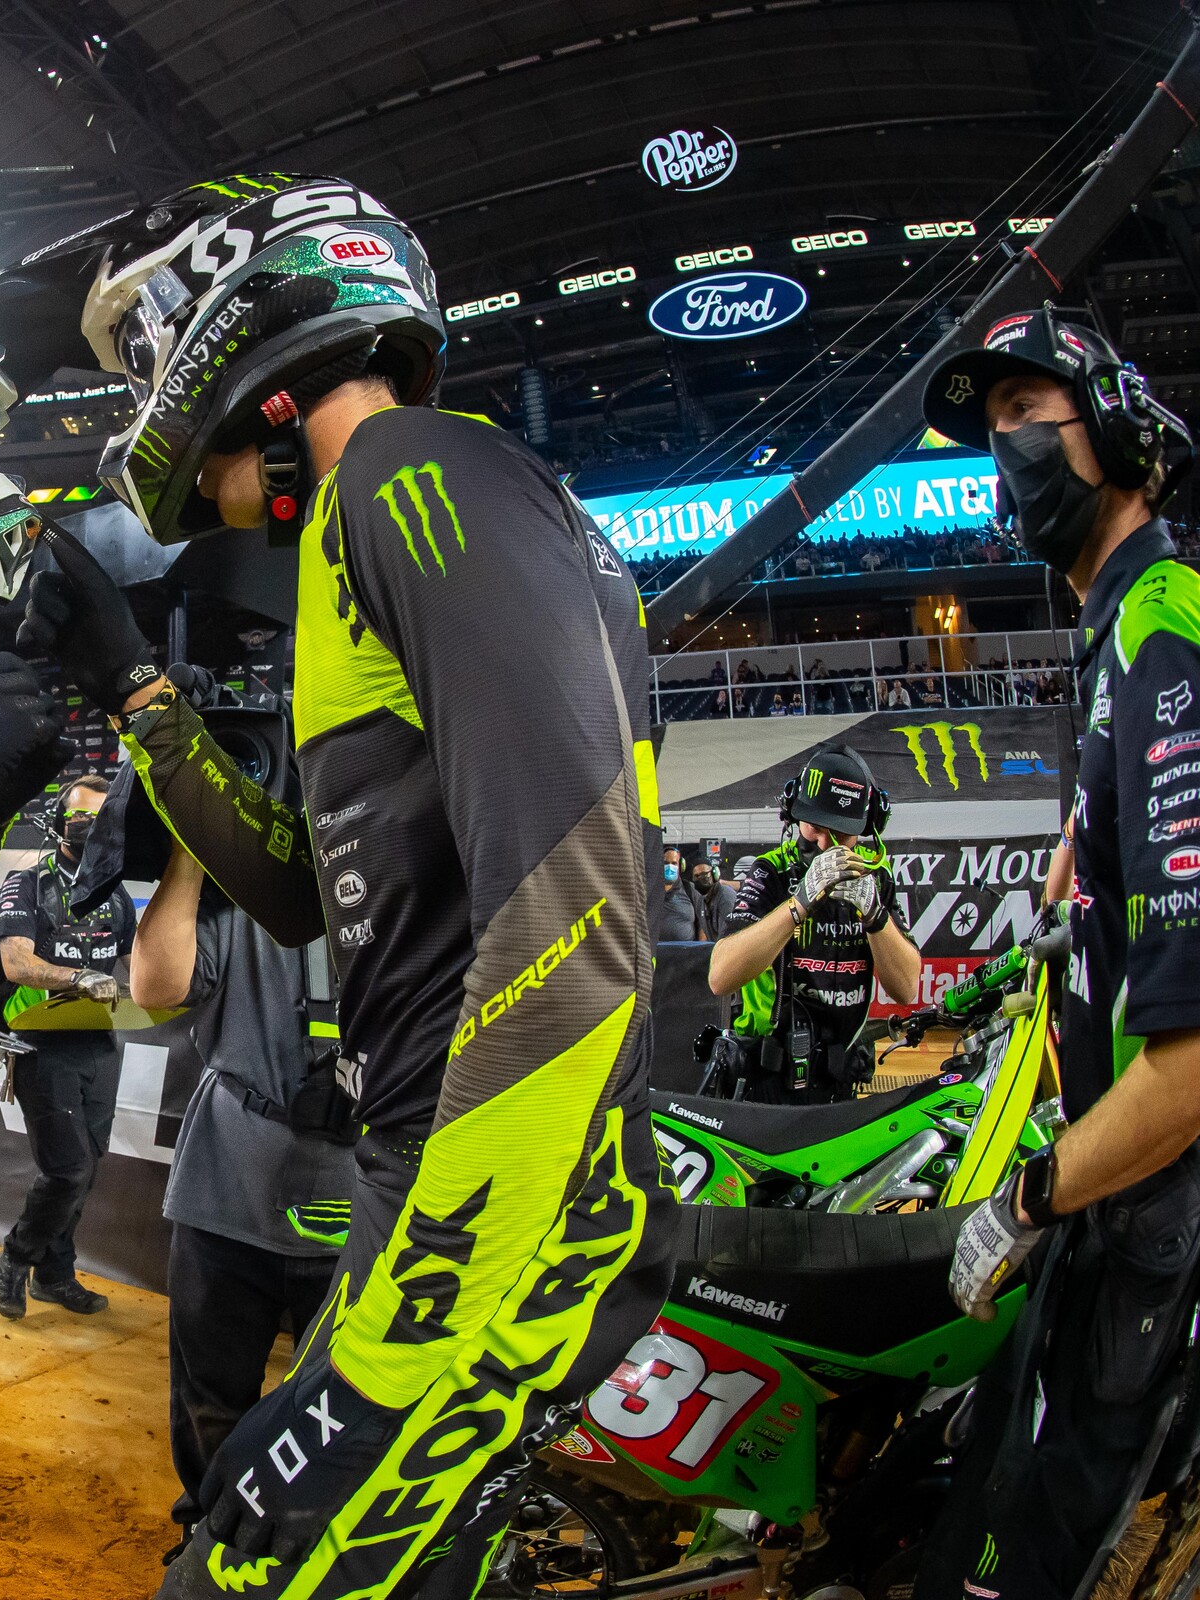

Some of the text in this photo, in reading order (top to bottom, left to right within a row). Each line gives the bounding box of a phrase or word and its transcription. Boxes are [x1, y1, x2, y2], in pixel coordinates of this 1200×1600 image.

[669, 130, 704, 159] Dr
[791, 230, 868, 254] GEICO
[903, 220, 977, 241] GEICO
[330, 239, 386, 261] BELL
[675, 246, 754, 272] GEICO
[558, 266, 636, 295] GEICO
[445, 292, 520, 321] GEICO
[681, 282, 778, 331] Ford
[152, 296, 255, 421] MONSTER
[181, 326, 250, 414] ENERGY
[25, 383, 128, 404] More Than Just Car
[593, 497, 738, 549] TADIUM
[874, 490, 903, 519] BY
[1005, 750, 1042, 760] AMA
[1169, 816, 1200, 834] RENT
[327, 838, 361, 862] SCOTT
[339, 878, 362, 899] BELL
[1150, 887, 1200, 918] MON
[482, 897, 608, 1027] CIRCUIT
[793, 981, 866, 1007] Kawasak
[667, 1102, 724, 1131] Kawasaki
[686, 1276, 789, 1323] Kawasaki
[808, 1361, 868, 1380] 250
[588, 1333, 766, 1468] 31
[236, 1388, 346, 1519] FOX
